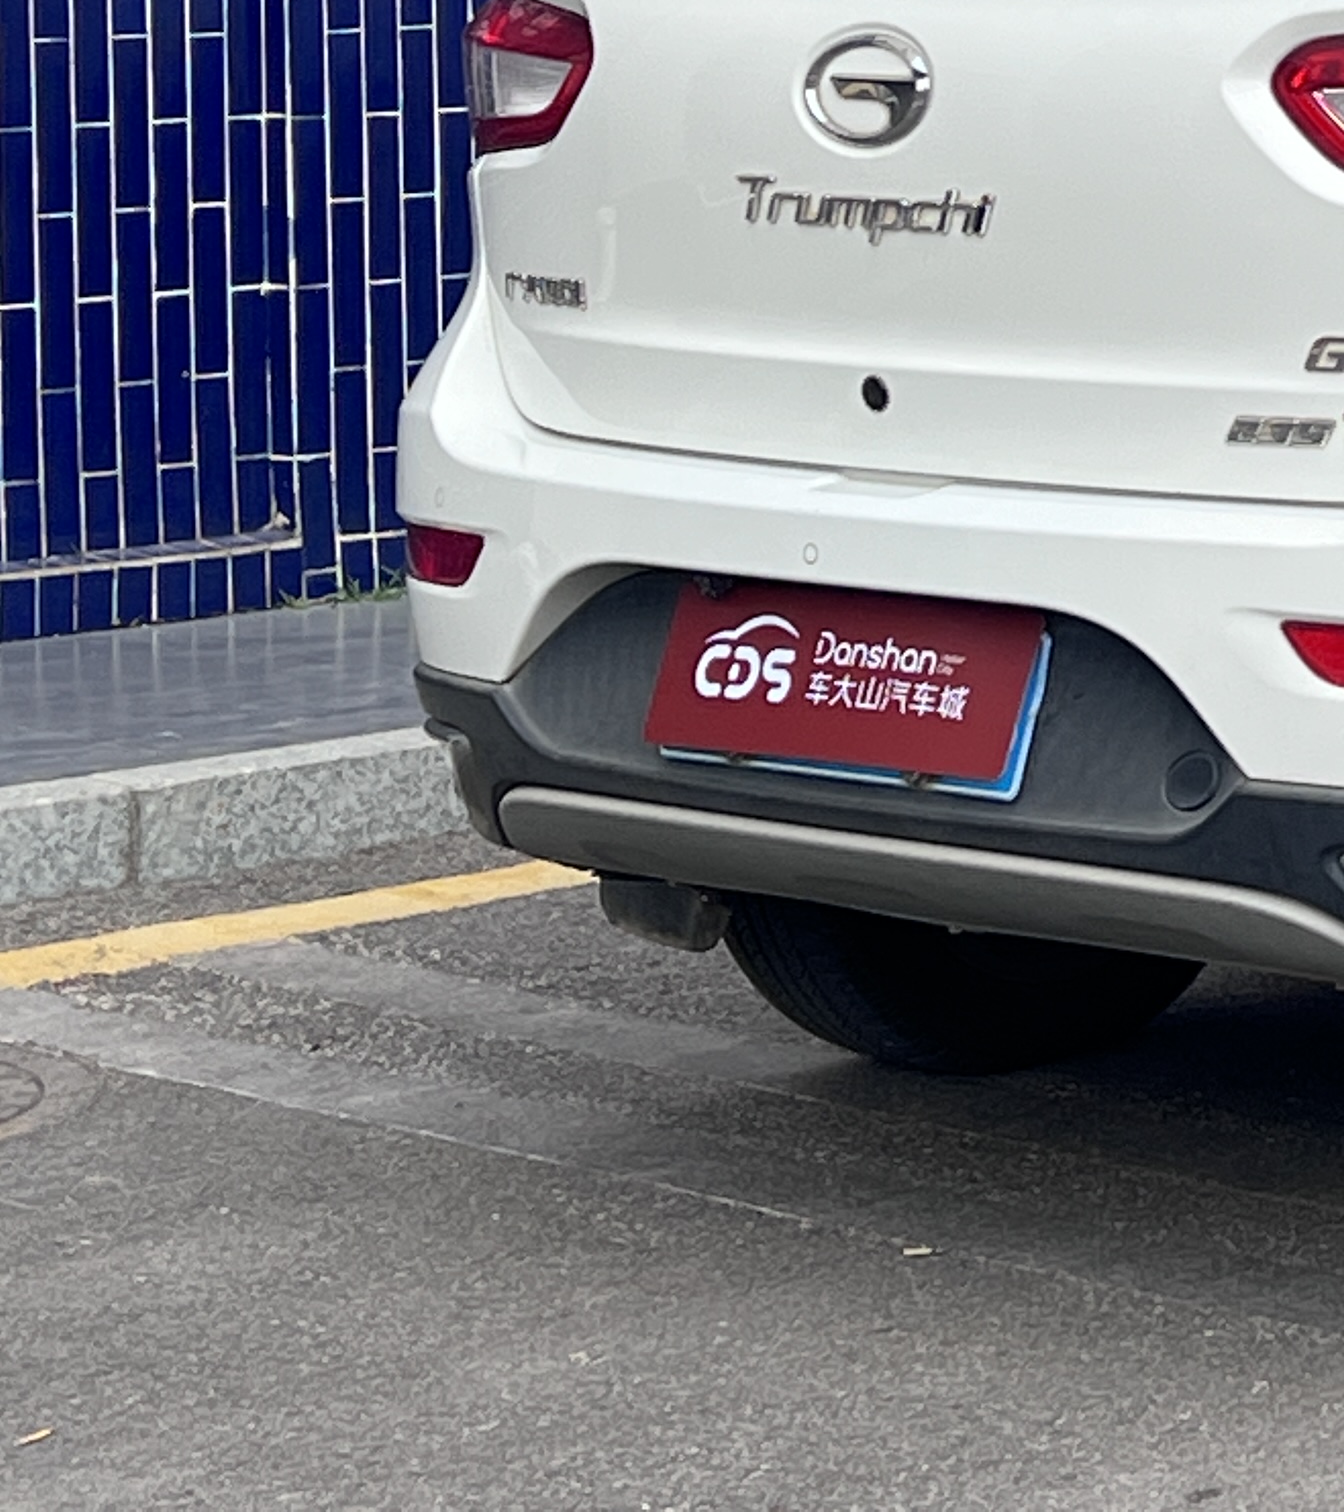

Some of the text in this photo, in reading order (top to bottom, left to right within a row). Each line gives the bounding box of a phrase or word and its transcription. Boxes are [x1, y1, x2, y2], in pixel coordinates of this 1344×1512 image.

[735, 174, 997, 246] Trumpchi
[813, 631, 937, 676] Danshan
[804, 671, 970, 720] 车大山汽车城
